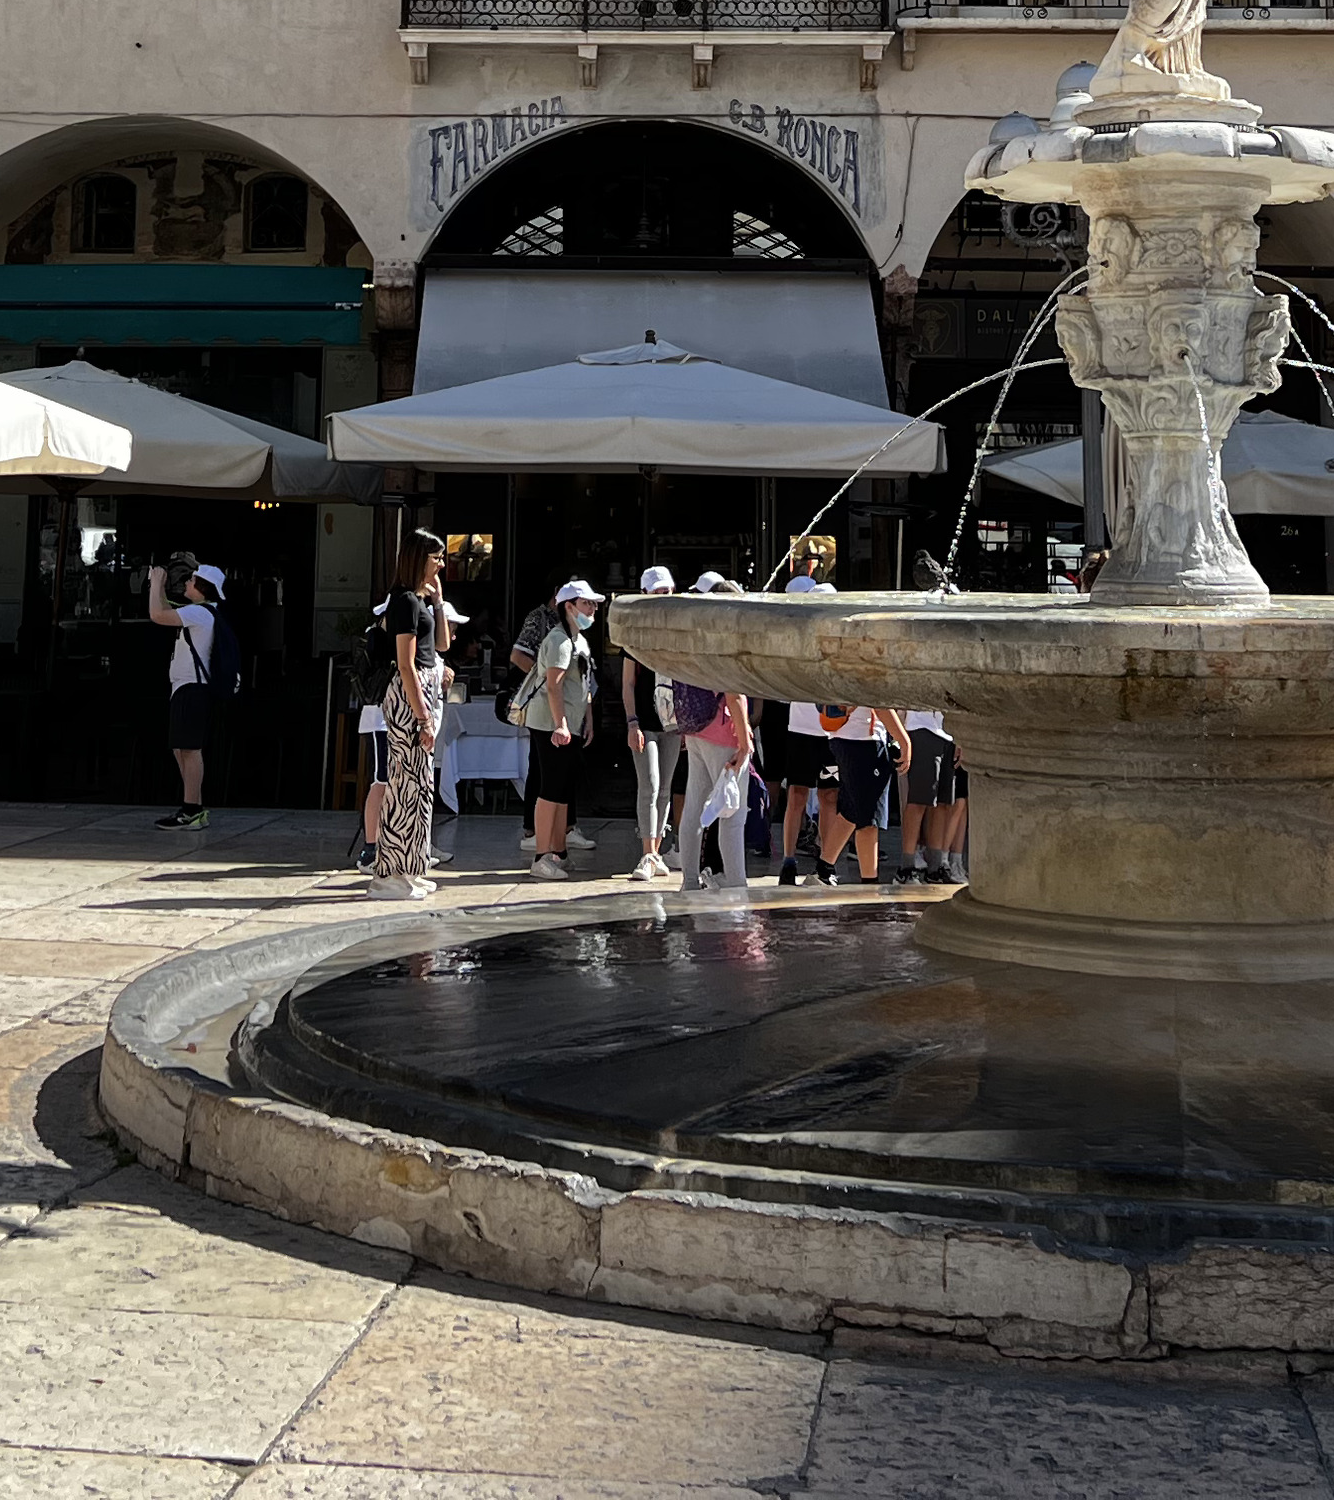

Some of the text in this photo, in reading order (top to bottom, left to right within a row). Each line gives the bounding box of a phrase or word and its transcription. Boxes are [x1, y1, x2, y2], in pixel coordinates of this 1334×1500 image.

[428, 95, 568, 213] FARMACIA
[775, 105, 862, 219] RONCA
[977, 309, 1015, 322] DAL
